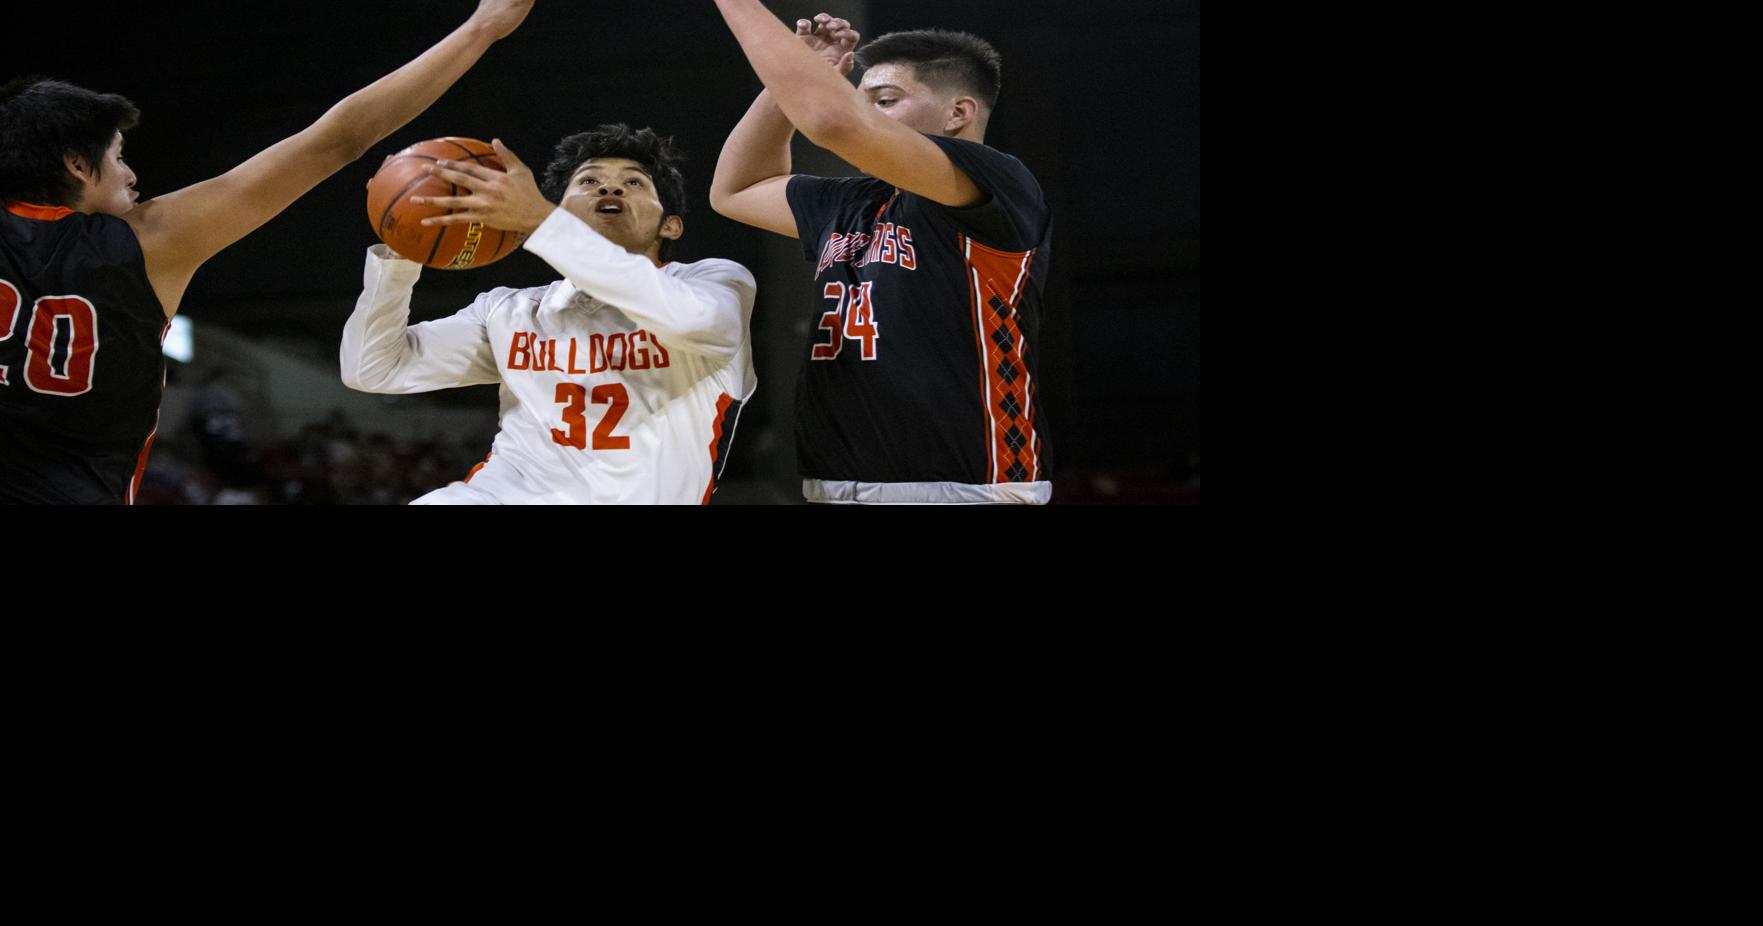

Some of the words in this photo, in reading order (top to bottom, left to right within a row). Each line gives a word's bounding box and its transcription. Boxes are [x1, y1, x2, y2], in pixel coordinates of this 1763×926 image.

[507, 328, 671, 375] BULLDOGS
[811, 280, 880, 361] 34
[550, 382, 631, 451] 32
